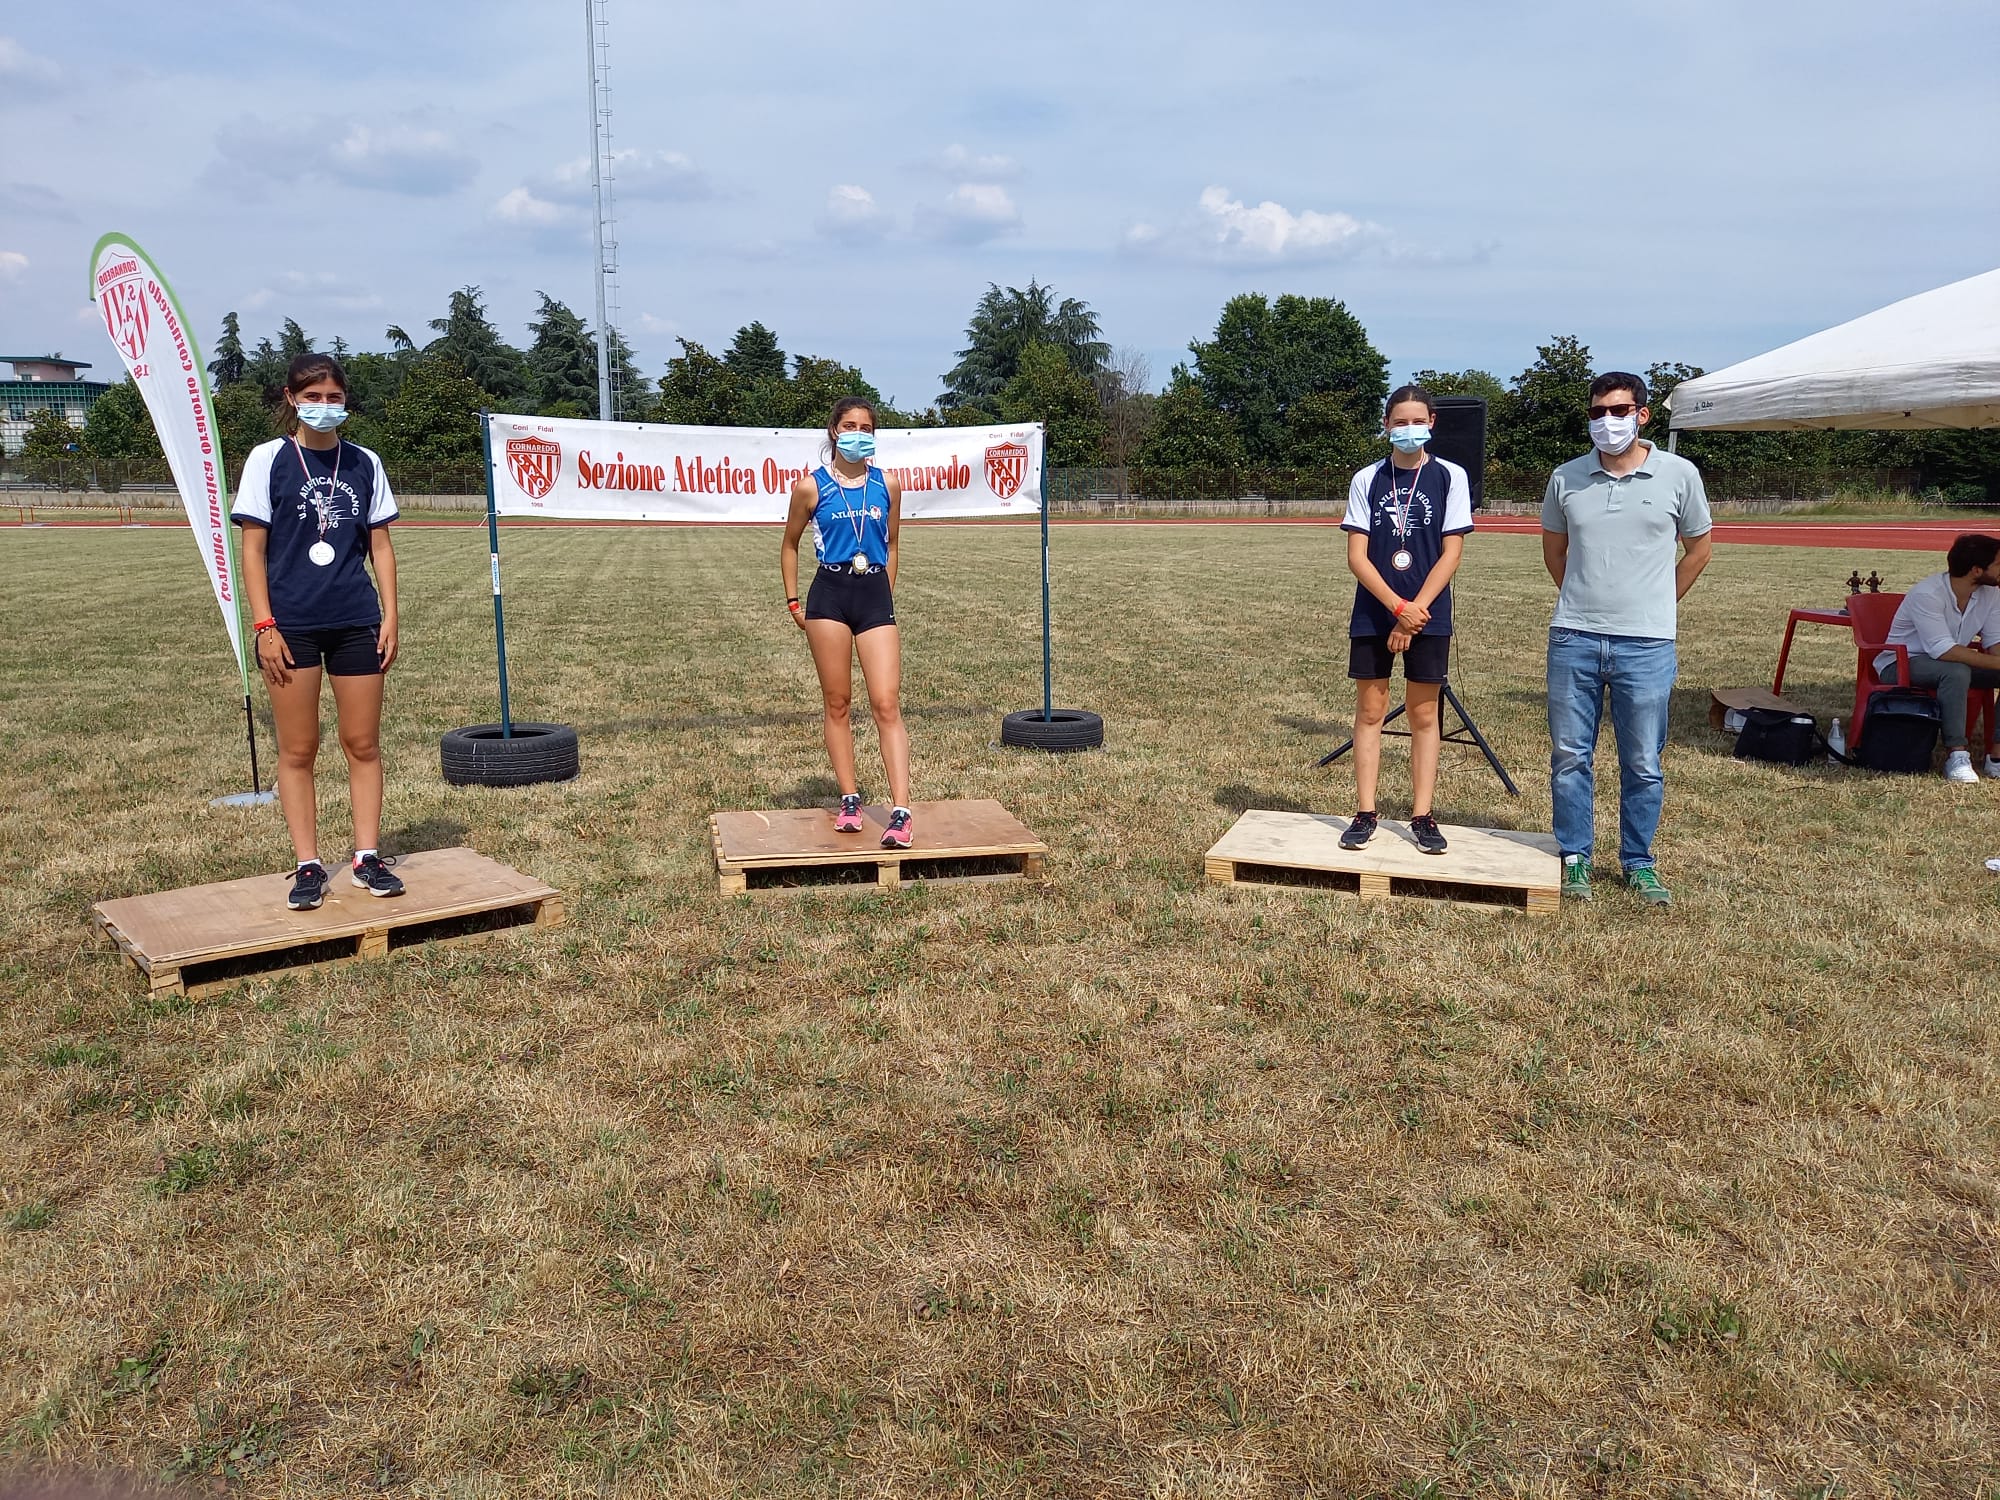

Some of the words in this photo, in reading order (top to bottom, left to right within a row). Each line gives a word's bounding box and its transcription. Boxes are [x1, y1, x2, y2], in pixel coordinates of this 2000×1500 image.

[537, 425, 554, 433] Fidal
[511, 442, 556, 453] CORNAREDO
[989, 448, 1024, 457] CORNAREDO
[577, 449, 666, 492] Sezione
[673, 455, 757, 495] Atletica
[762, 457, 810, 495] Orat
[297, 501, 307, 520] U.S.
[335, 479, 360, 516] VEDANO
[1374, 509, 1382, 526] U.S.
[1415, 490, 1433, 525] VEDANO
